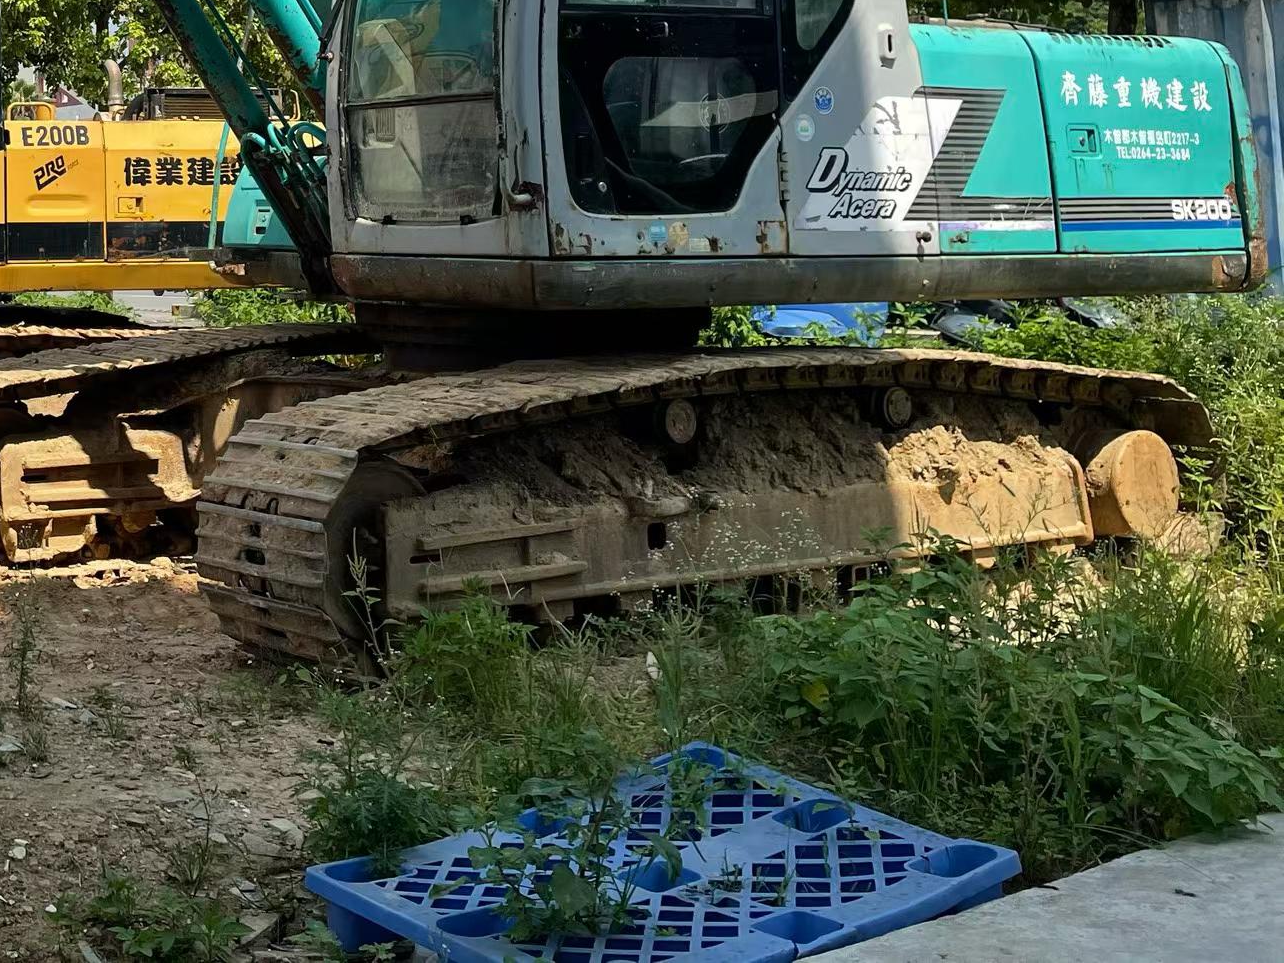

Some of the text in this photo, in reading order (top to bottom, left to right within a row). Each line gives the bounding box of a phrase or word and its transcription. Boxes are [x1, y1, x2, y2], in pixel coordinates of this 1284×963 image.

[21, 125, 90, 147] E200B
[33, 155, 67, 191] PRO
[806, 146, 913, 197] Dynamic
[827, 192, 897, 219] Acera
[1171, 199, 1232, 221] SK200
